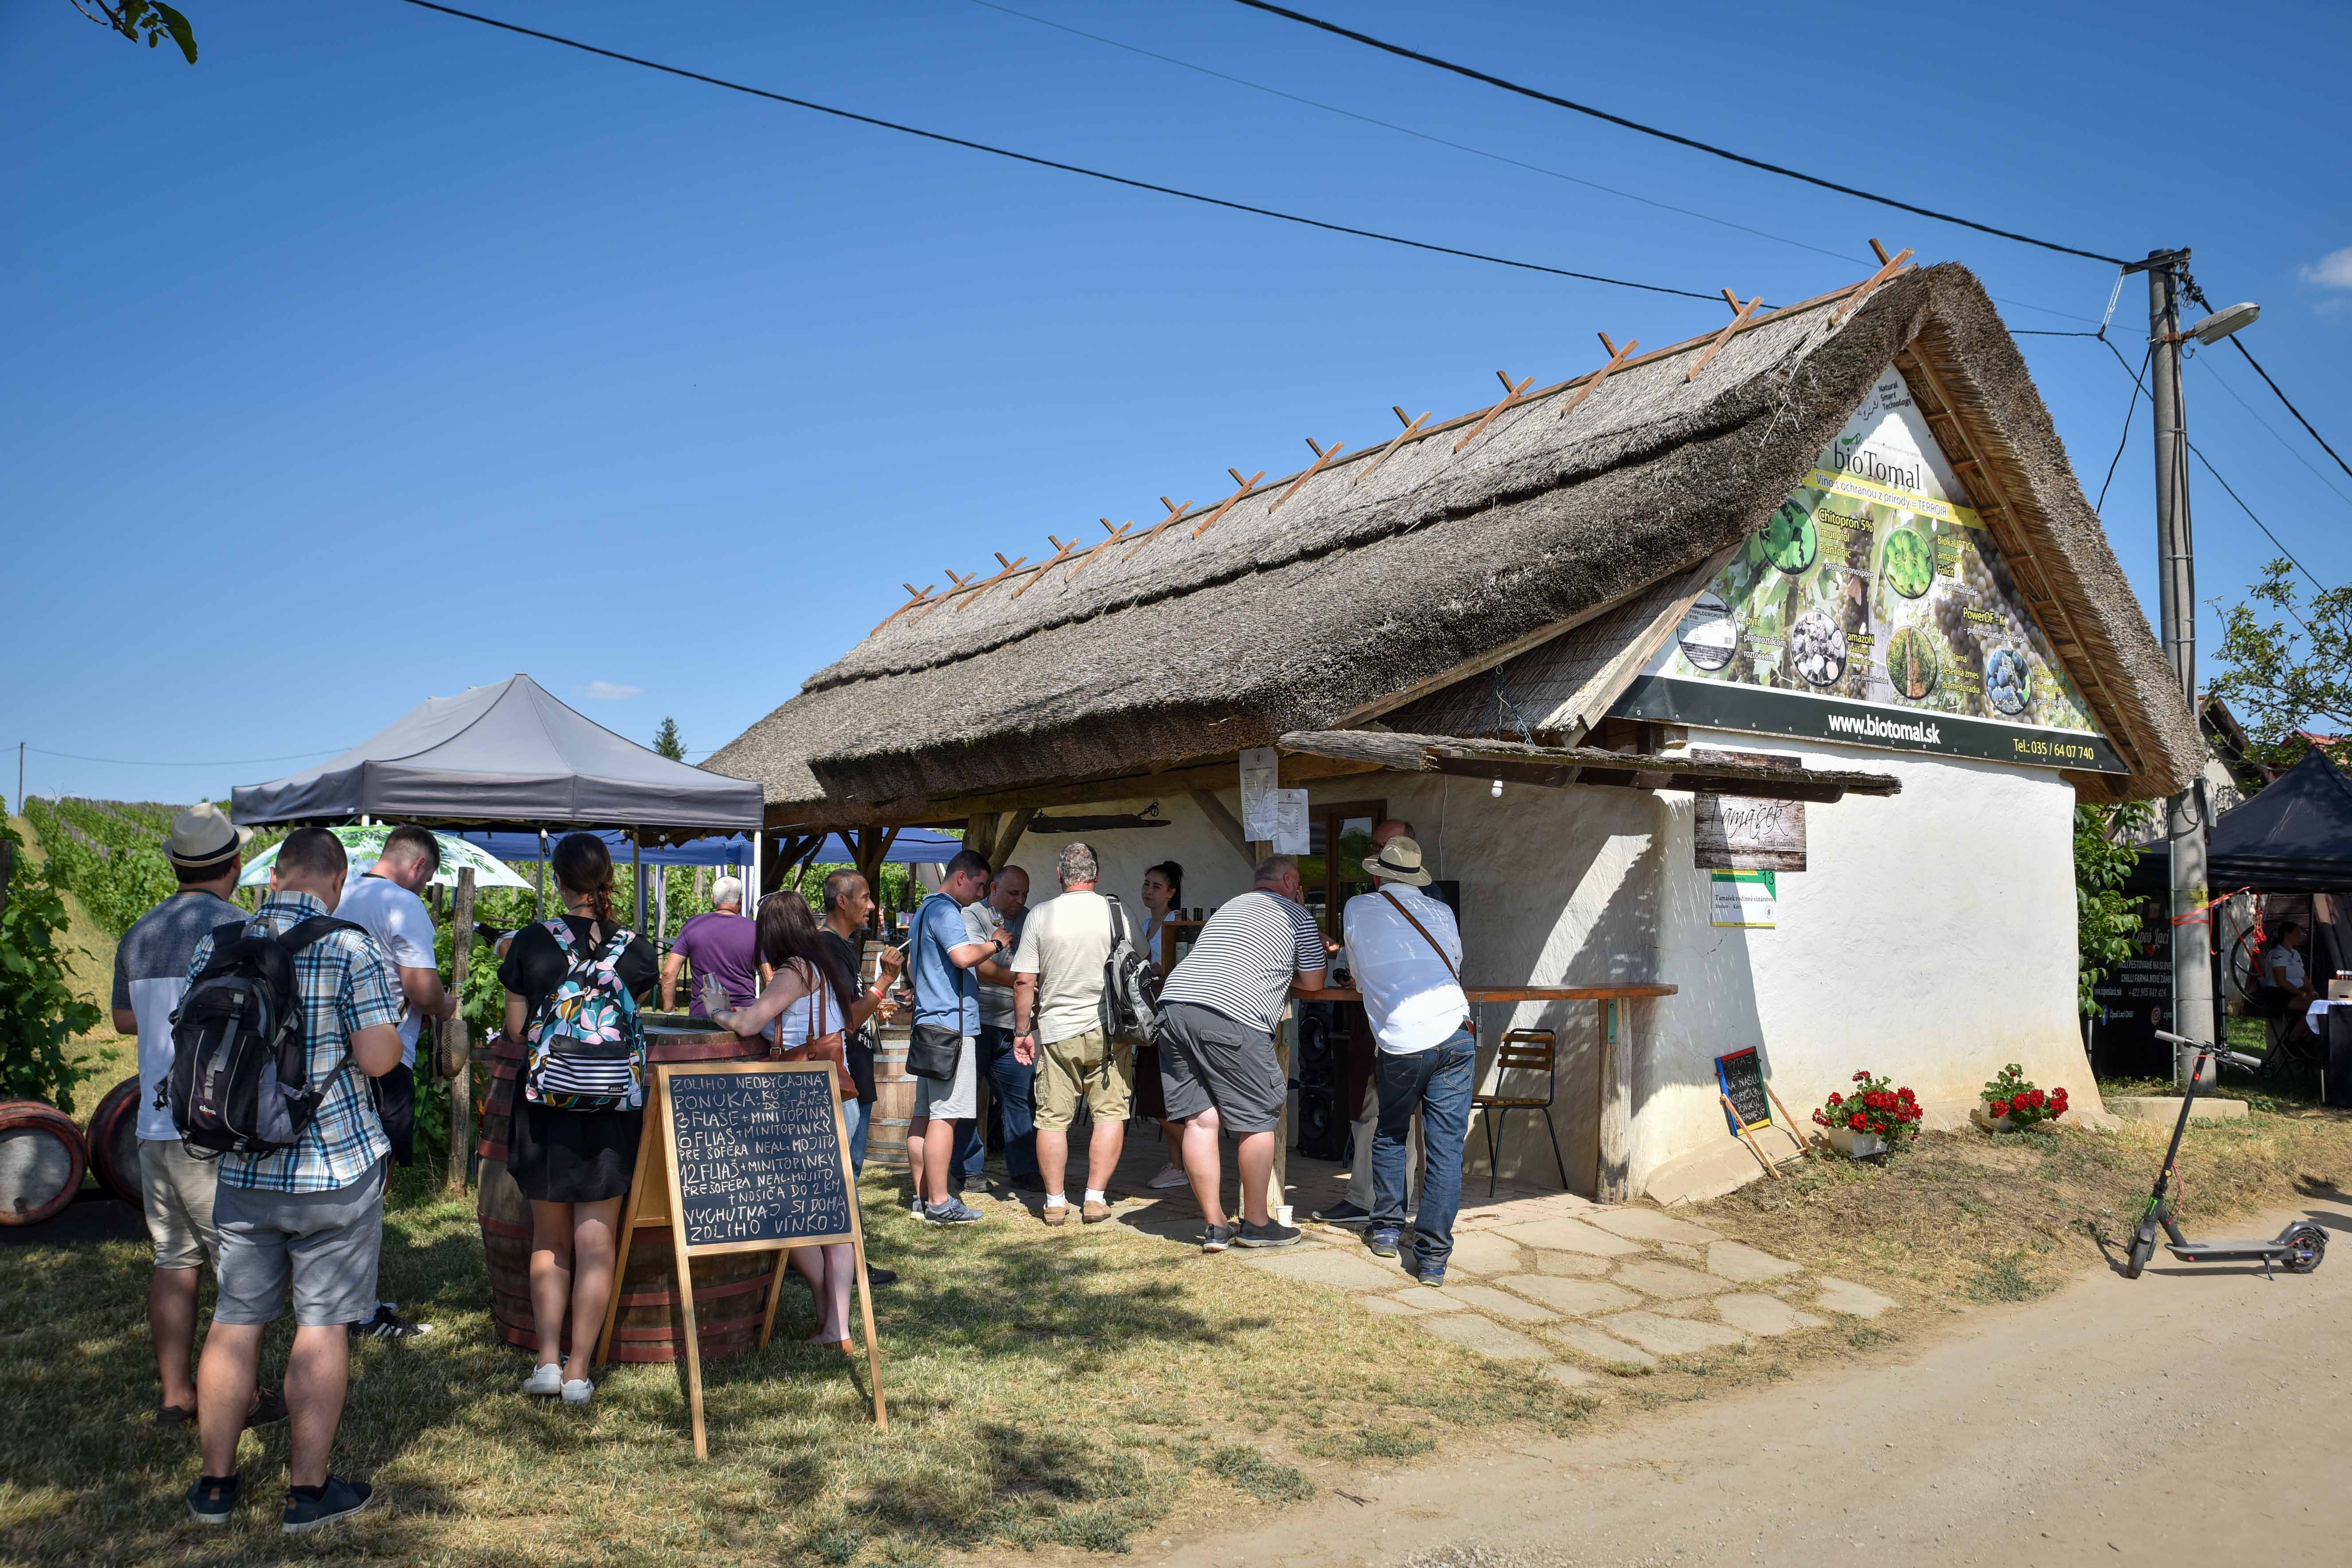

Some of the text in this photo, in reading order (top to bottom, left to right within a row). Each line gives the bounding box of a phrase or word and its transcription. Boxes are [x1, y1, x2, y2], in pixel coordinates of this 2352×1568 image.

[1878, 381, 1898, 392] Natural
[1880, 392, 1896, 401] Smart
[1882, 398, 1911, 411] Technology
[1834, 440, 1921, 490] bioTomal
[1816, 473, 1834, 487] Víno
[1841, 481, 1876, 498] ochranou
[1884, 493, 1910, 509] prírody
[1917, 500, 1947, 516] TERROIR
[1818, 509, 1874, 533] Chitopron 5%
[1819, 527, 1849, 542] Imunofol
[1819, 543, 1851, 559] PlanTonic
[1826, 564, 1839, 575] proti
[1840, 567, 1874, 579] peronospóre
[1689, 609, 1723, 619] TYPHLODROMUS
[1963, 607, 1994, 623] PowerOF
[1746, 616, 1760, 628] pyri
[1847, 633, 1875, 645] amazoN
[1967, 628, 1979, 637] proti
[1744, 634, 1758, 644] proti
[1759, 636, 1788, 648] roztočom,
[1847, 644, 1870, 655] PlanTonic
[1952, 652, 1967, 663] Jarná
[1965, 671, 1979, 679] zmes
[1949, 683, 1980, 694] medziradia
[1828, 714, 1941, 745] www.biotomal.sk
[2013, 738, 2030, 753] Tel.:
[2031, 741, 2047, 755] 035
[2054, 744, 2065, 757] 64
[2066, 745, 2076, 758] 07
[2078, 746, 2094, 760] 740
[1758, 838, 1795, 847] Rodinné vinárstvo
[1762, 871, 1774, 885] 13
[672, 1078, 726, 1092] ZOLIHO
[675, 1112, 690, 1129] 3
[692, 1108, 739, 1127] FLAŠE
[677, 1130, 691, 1149] 6
[678, 1148, 700, 1161] PRE
[707, 1143, 749, 1160] ŠOFERA
[680, 1163, 700, 1188] 12
[682, 1184, 707, 1197] PRE
[739, 1185, 785, 1204] NOSIČA
[792, 1184, 807, 1197] DO
[813, 1183, 821, 1195] 2
[824, 1179, 841, 1193] KM
[684, 1193, 847, 1226] VYCHUTNAJ SI DOMA
